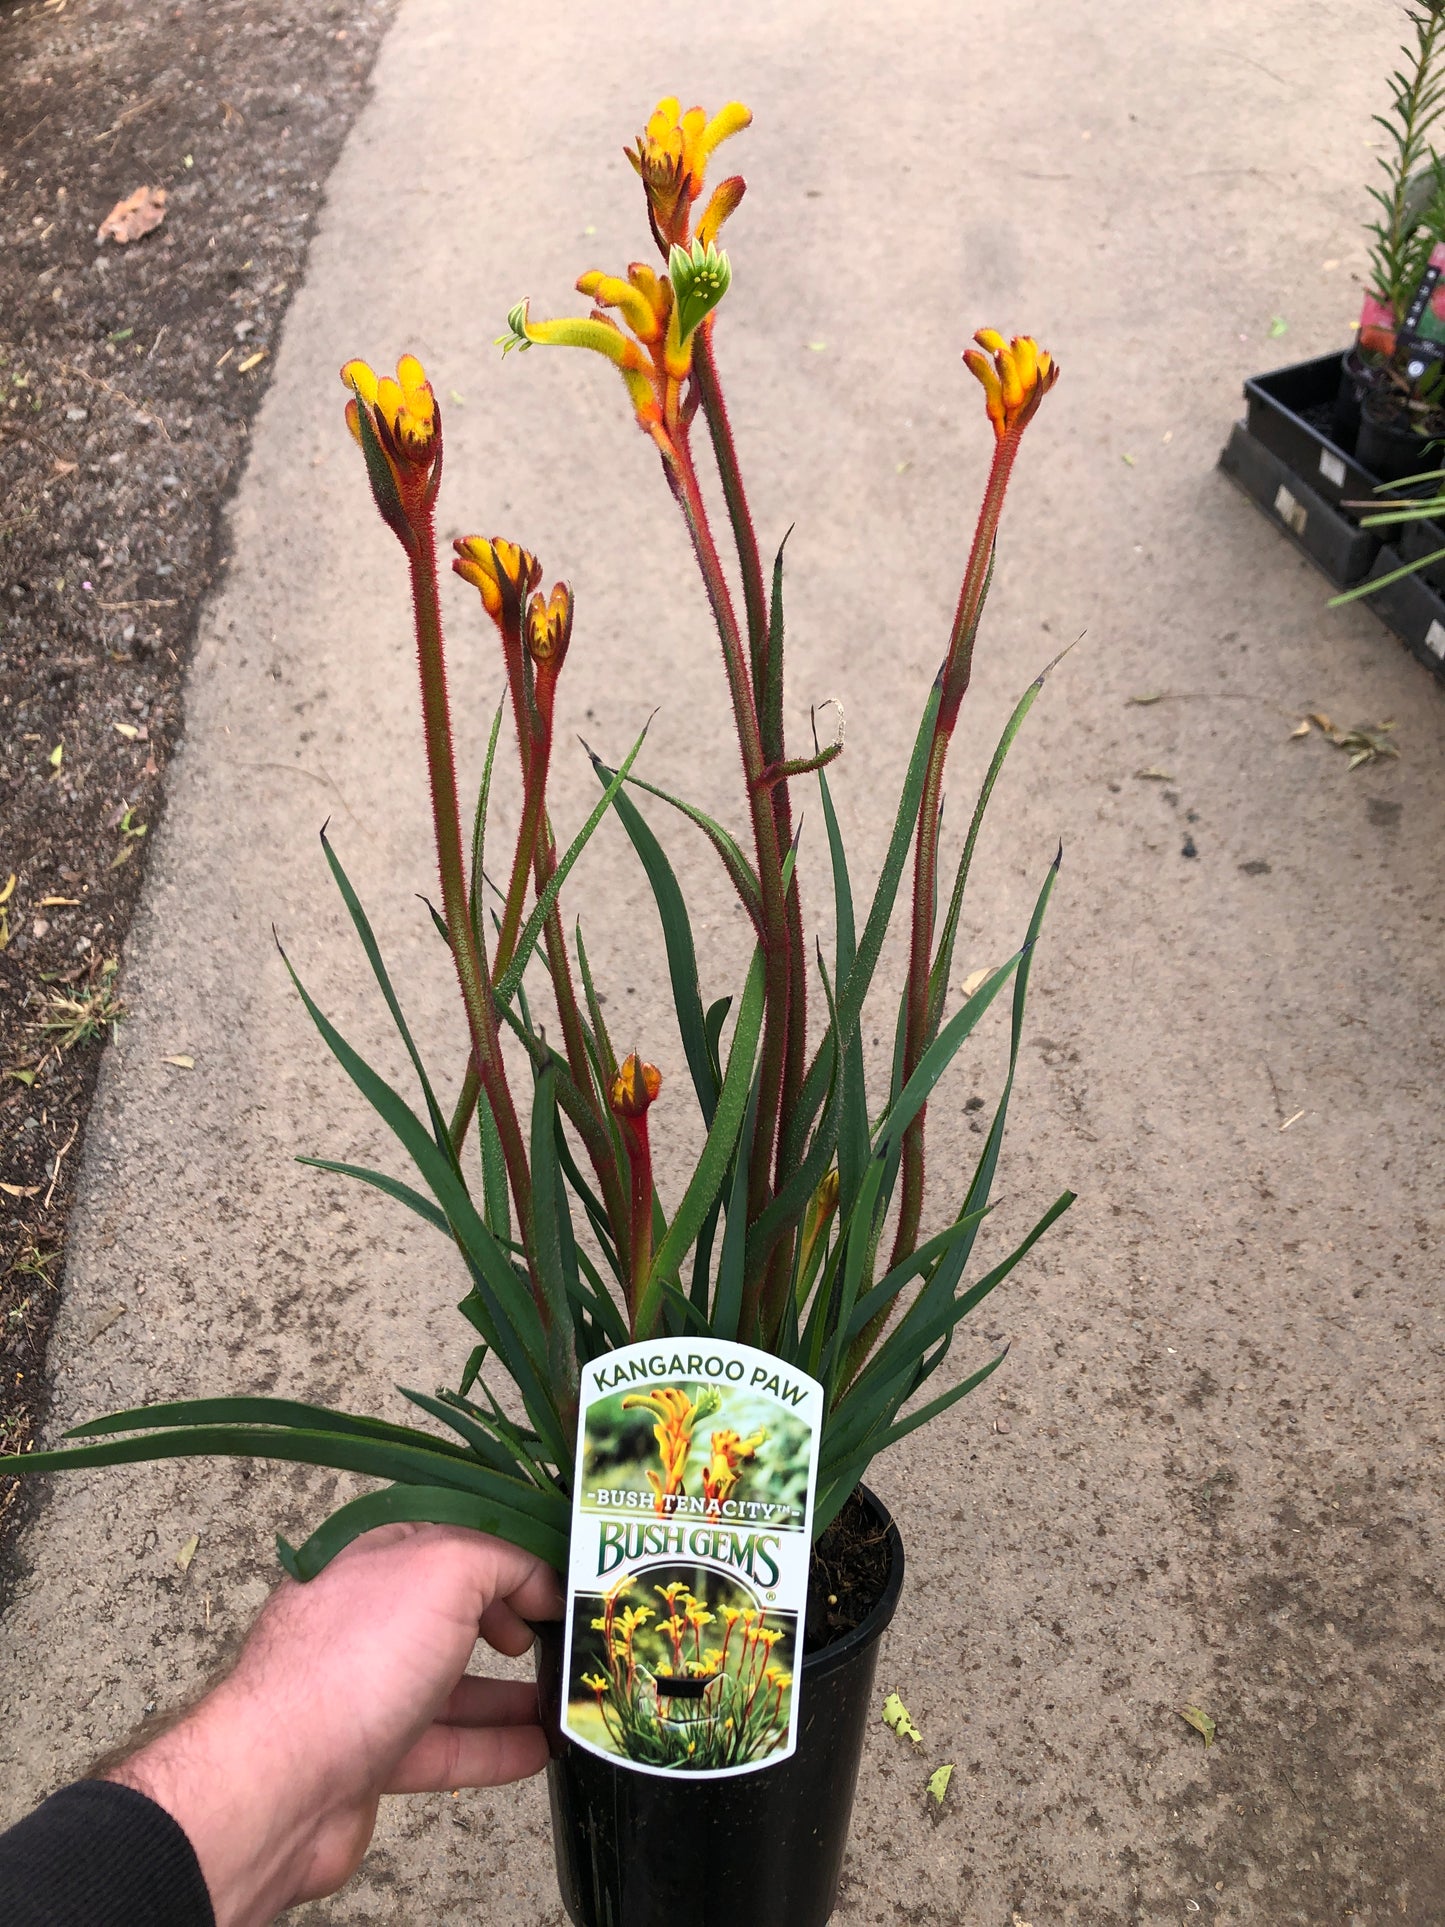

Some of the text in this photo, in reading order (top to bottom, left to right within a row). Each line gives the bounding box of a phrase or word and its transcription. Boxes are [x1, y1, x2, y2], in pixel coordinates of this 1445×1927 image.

[592, 1354, 809, 1407] KANGAROO PAW
[596, 1520, 782, 1589] BUSH GEMS
